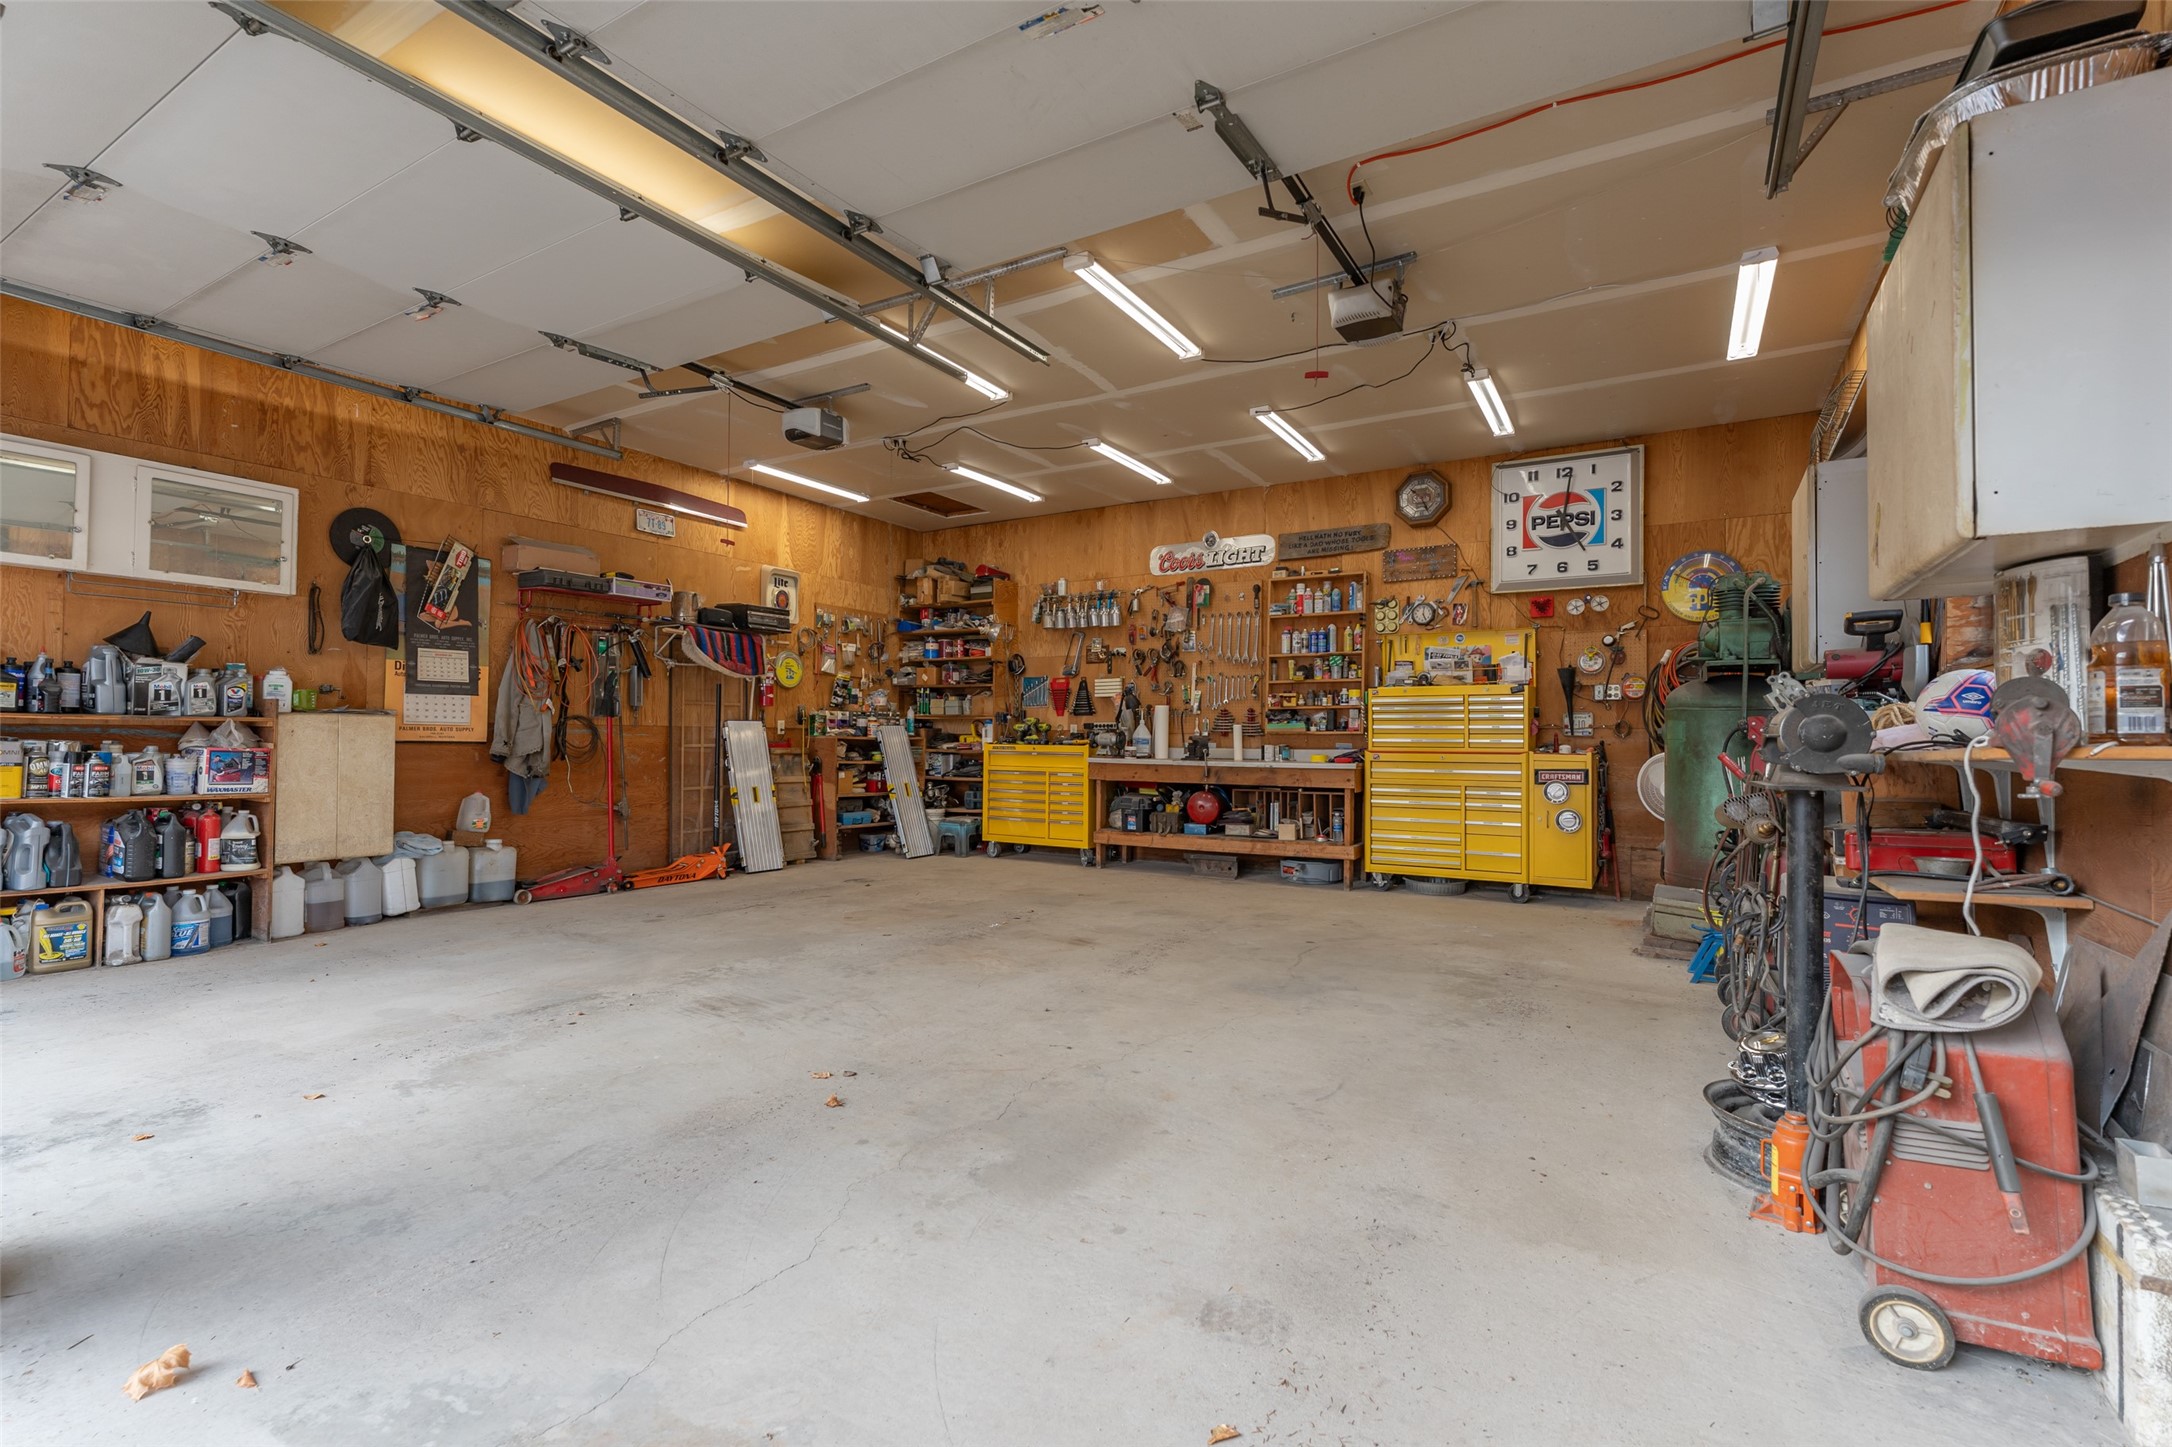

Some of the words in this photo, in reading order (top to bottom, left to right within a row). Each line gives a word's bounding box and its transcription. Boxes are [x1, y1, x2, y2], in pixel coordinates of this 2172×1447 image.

[1556, 467, 1573, 479] 12
[1591, 464, 1596, 474] 1
[1528, 470, 1539, 482] 11
[1611, 481, 1623, 492] 2
[1503, 492, 1520, 503] 10
[1531, 510, 1596, 531] PEPSI
[1611, 509, 1623, 521] 3
[1506, 520, 1517, 530] 9
[1314, 532, 1332, 540] HATH
[1324, 538, 1349, 546] WHOSE
[1611, 538, 1624, 549] 4
[1506, 546, 1517, 557] 8
[1158, 550, 1205, 573] Coors
[1206, 546, 1267, 568] LIGHT
[1527, 564, 1538, 575] 7
[1557, 562, 1568, 573] 6
[1587, 560, 1599, 571] 5
[773, 577, 789, 588] Lite
[656, 872, 697, 883] DAYTONA
